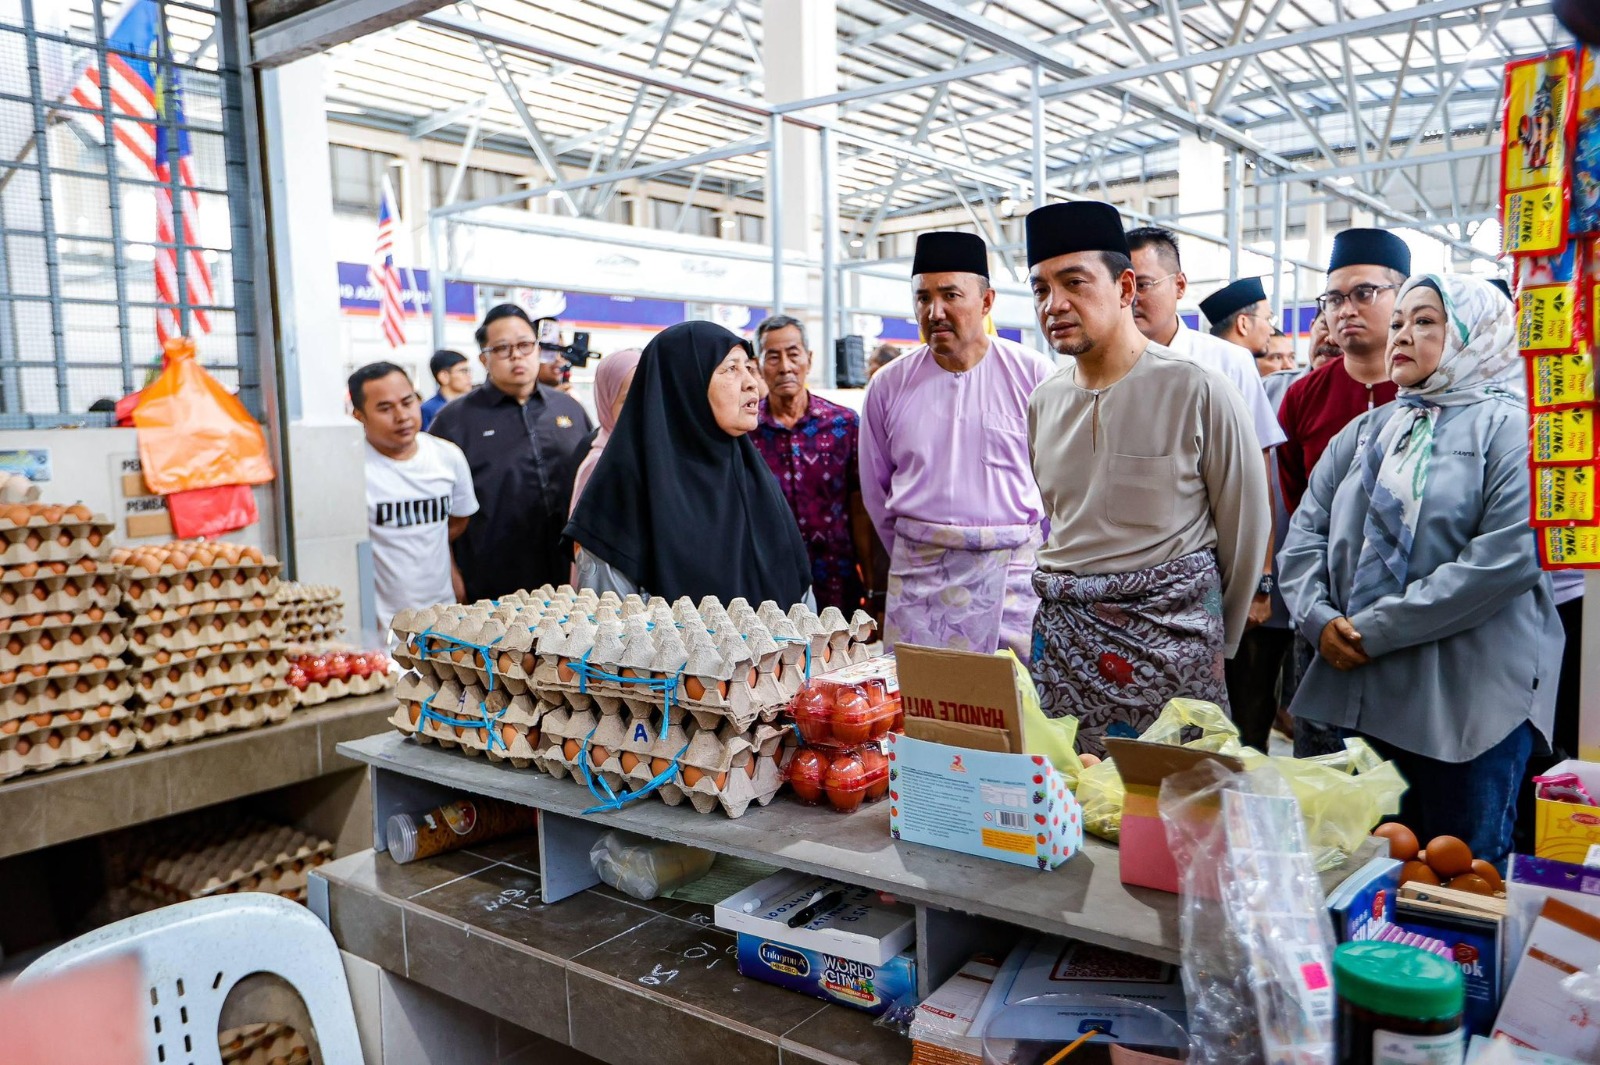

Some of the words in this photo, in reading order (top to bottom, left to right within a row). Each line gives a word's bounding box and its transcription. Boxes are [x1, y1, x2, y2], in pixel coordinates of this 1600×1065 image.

[1521, 200, 1534, 242] FLYING
[1532, 298, 1544, 341] FLYING
[1554, 469, 1565, 513] FLYING
[376, 496, 450, 528] PUMA
[1564, 527, 1576, 556] YING
[938, 700, 1006, 730] HANDLE
[633, 723, 648, 743] A
[822, 953, 875, 981] WORLD
[824, 969, 856, 989] CITY
